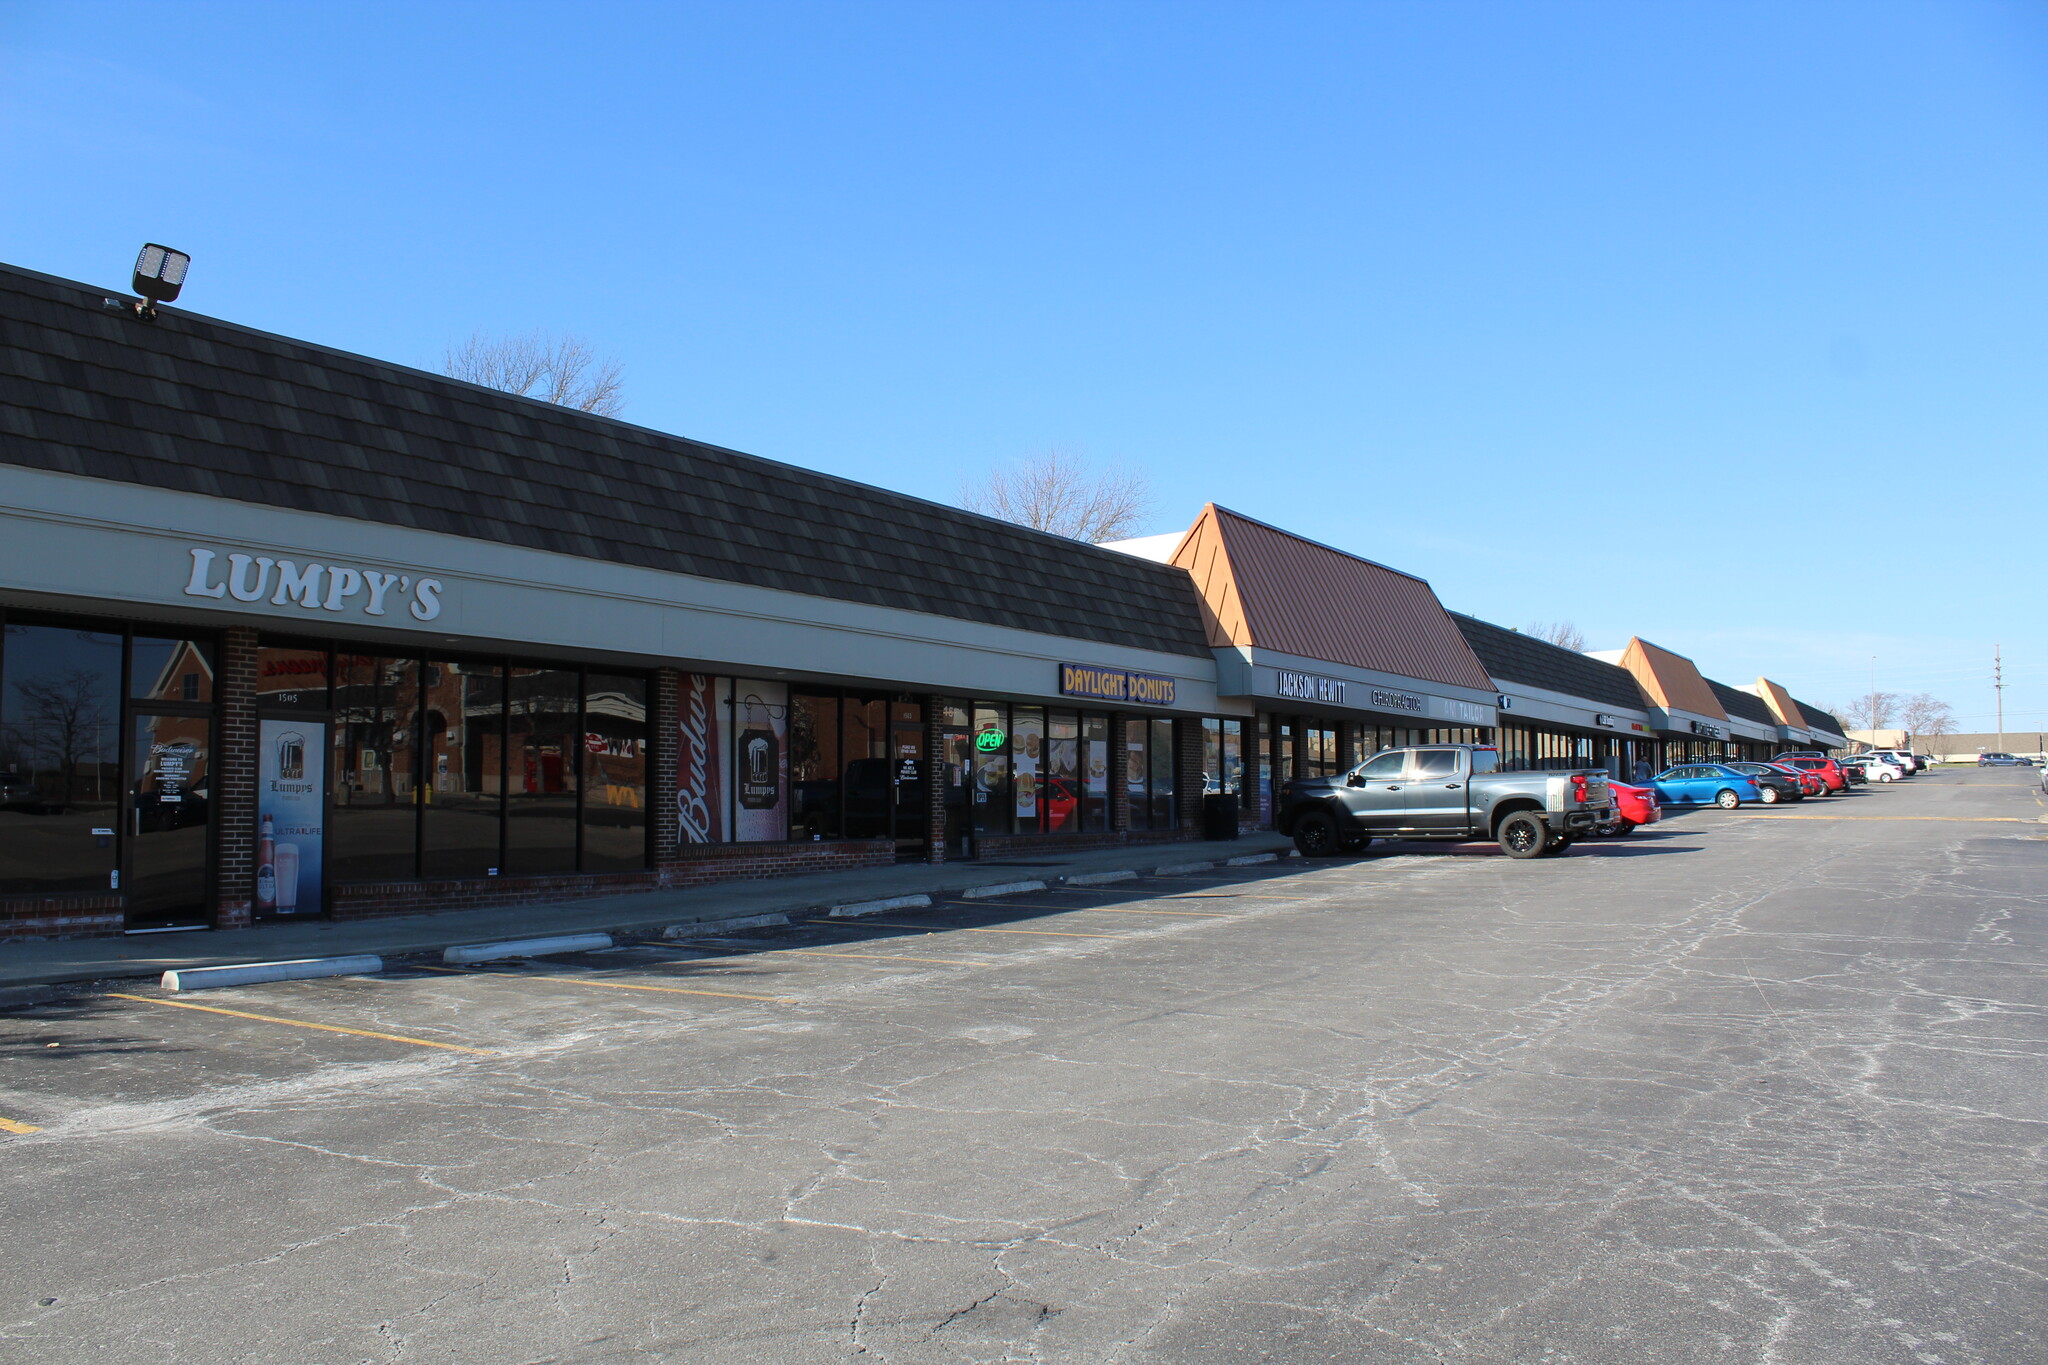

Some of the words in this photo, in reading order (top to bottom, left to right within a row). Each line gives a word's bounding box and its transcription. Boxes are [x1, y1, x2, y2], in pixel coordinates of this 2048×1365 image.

[184, 548, 443, 622] LUMPY'S
[1065, 667, 1125, 697] DAYLIGHT
[1129, 675, 1175, 703] DONUTS
[1278, 671, 1315, 698] JACKSON
[1318, 678, 1346, 704] HEWITT
[279, 693, 298, 703] 1505
[1371, 689, 1422, 711] CHIROPRACTOR
[1459, 703, 1484, 723] TAILOR
[979, 733, 1001, 747] OPEN
[150, 744, 194, 754] Budweiser
[270, 780, 313, 794] Lumpys
[743, 783, 776, 797] Lumpys
